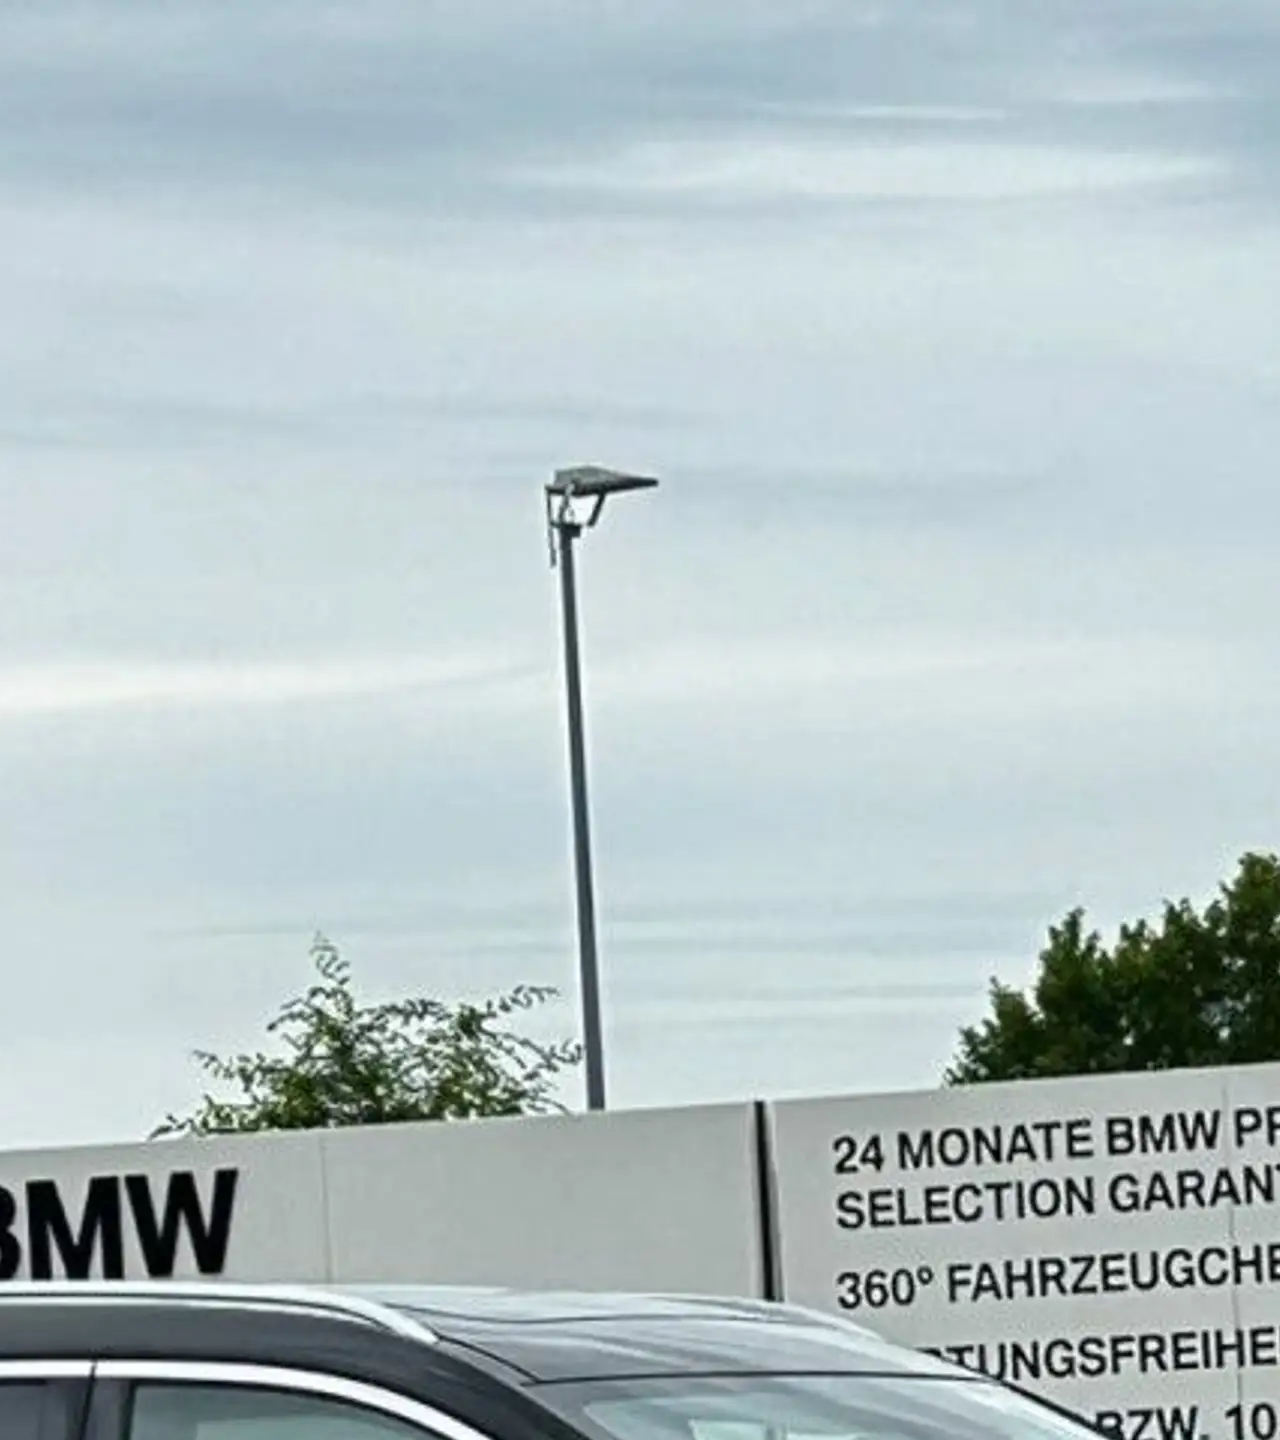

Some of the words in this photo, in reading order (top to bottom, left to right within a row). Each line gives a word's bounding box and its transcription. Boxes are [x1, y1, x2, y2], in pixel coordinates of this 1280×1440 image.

[832, 1133, 885, 1175] 24
[896, 1117, 1095, 1171] MONATE
[1105, 1108, 1221, 1156] BMW
[835, 1175, 1096, 1231] SELECTION
